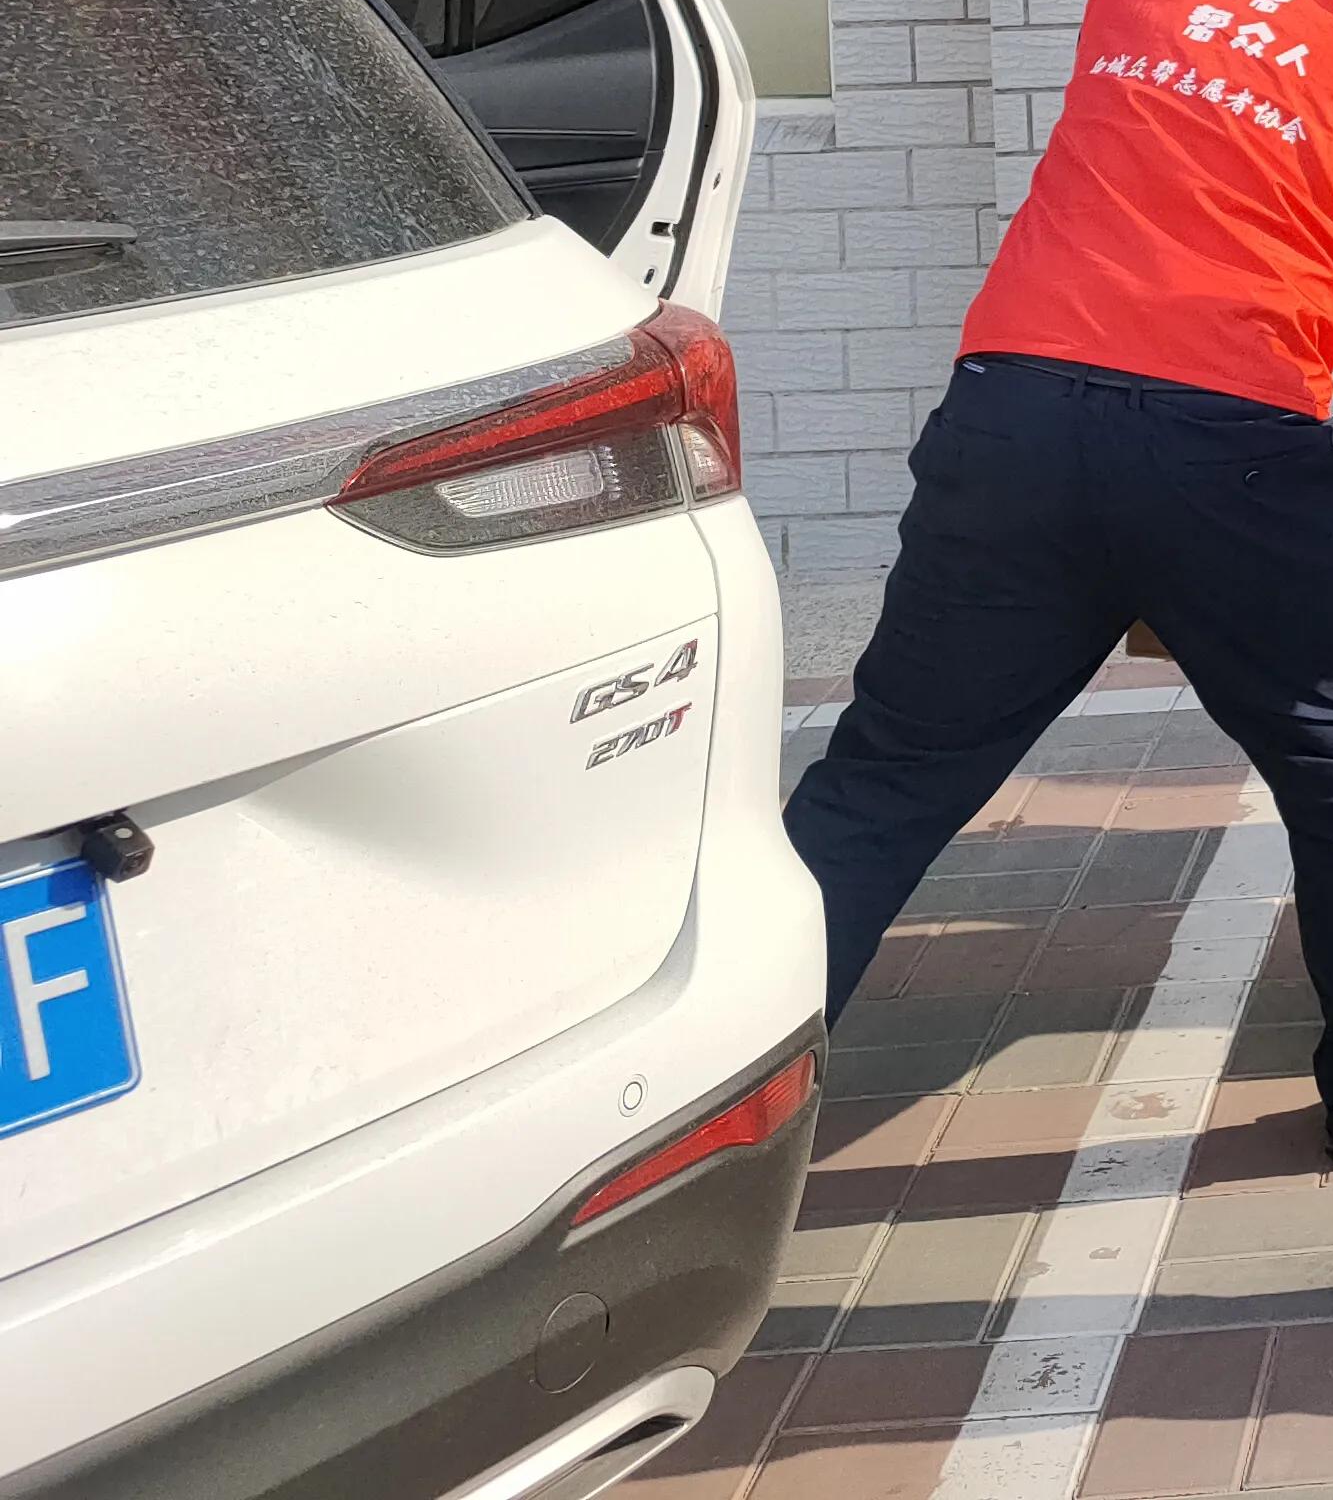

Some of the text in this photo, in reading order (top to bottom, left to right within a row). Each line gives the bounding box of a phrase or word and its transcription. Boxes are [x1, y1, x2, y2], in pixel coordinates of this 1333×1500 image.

[1182, 4, 1310, 78] 帮众人
[0, 899, 90, 1082] F
